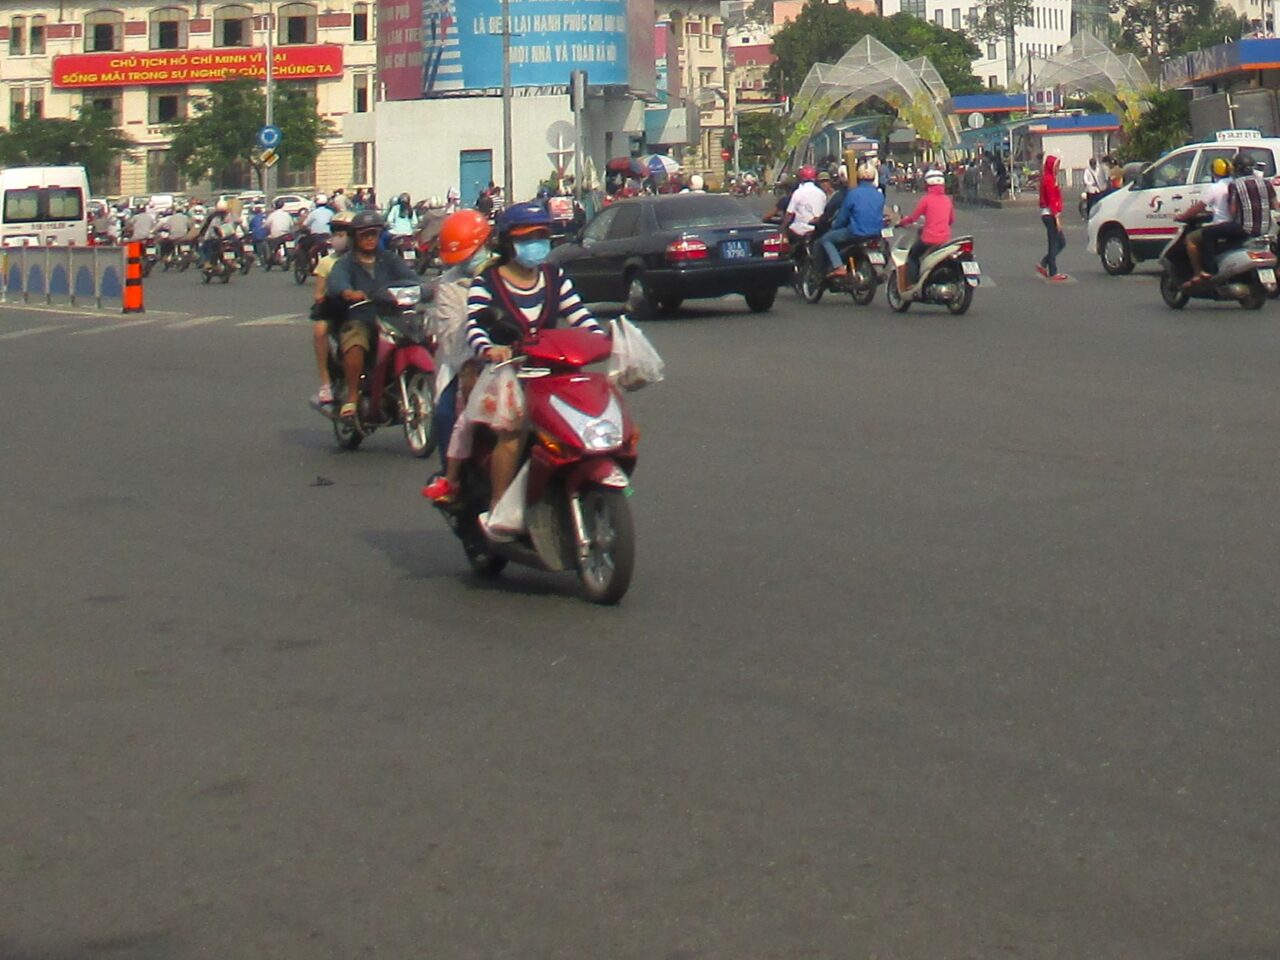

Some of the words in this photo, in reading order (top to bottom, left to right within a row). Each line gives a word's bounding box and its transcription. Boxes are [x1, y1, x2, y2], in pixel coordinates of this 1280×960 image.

[110, 56, 137, 68] CHỦ
[141, 57, 167, 69] TỊCH
[170, 54, 188, 66] HỒ
[191, 54, 212, 65] CHÍ
[215, 53, 246, 64] MINH
[62, 71, 98, 84] SỐNG
[101, 70, 125, 81] MÃI
[128, 70, 168, 81] TRONG
[271, 64, 316, 75] CHÚNG
[319, 64, 333, 73] TA
